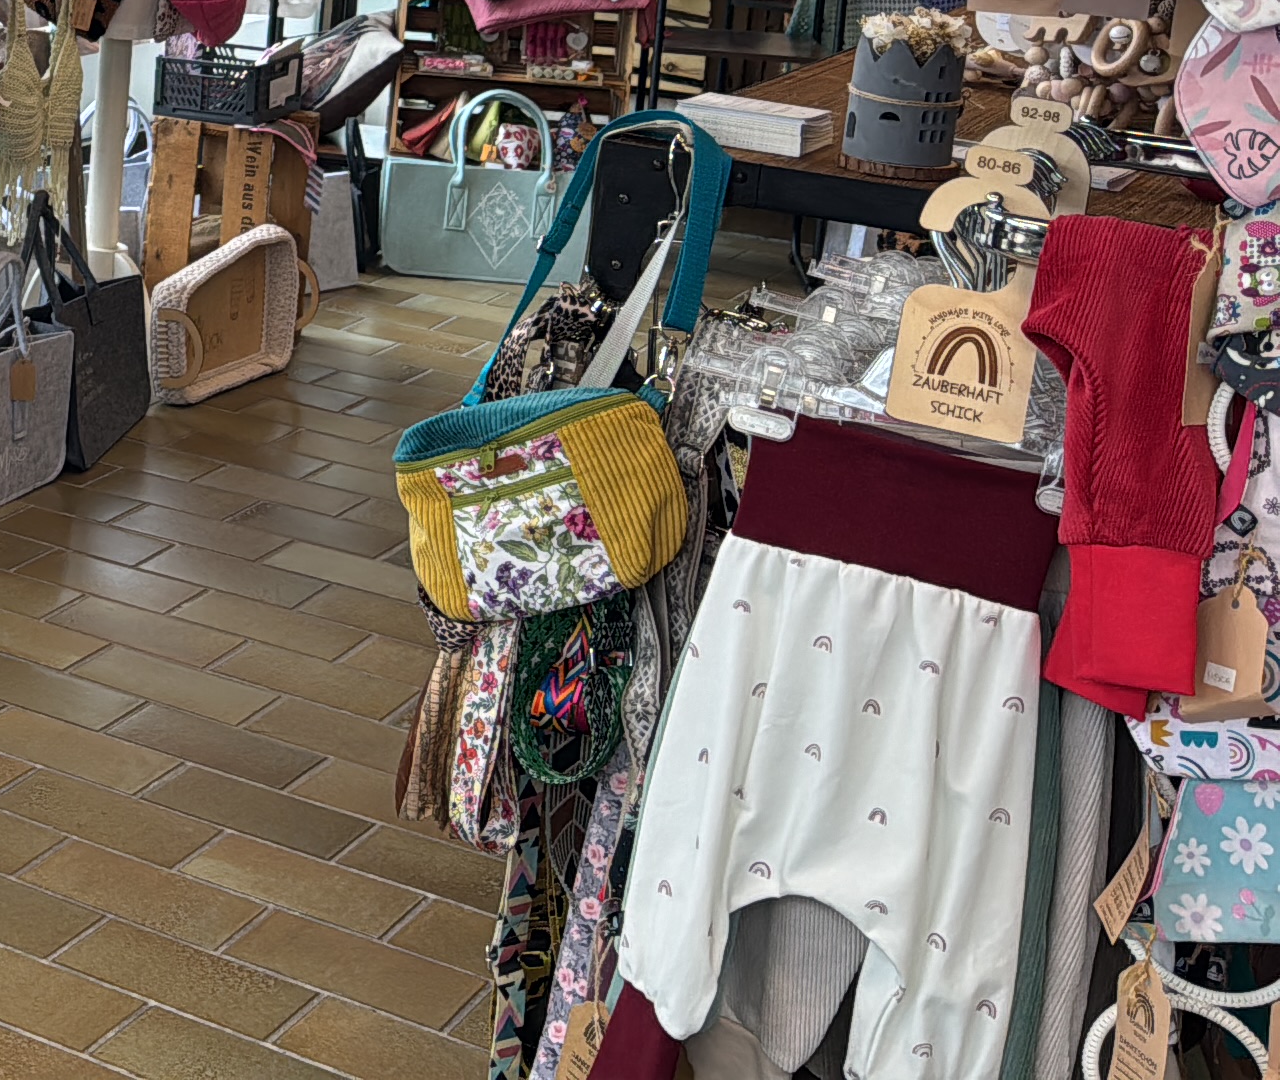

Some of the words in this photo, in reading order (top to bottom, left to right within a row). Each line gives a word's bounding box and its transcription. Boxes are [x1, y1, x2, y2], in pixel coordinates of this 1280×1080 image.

[1020, 107, 1061, 124] 92-98
[244, 139, 263, 178] Wein
[976, 155, 1022, 175] 80-86
[242, 182, 256, 211] aus
[928, 307, 970, 326] HANDMADE
[972, 309, 995, 325] WITH
[993, 321, 1013, 338] LOVE
[912, 373, 1004, 406] ZAUBERHAFT
[930, 400, 983, 424] SCHICK
